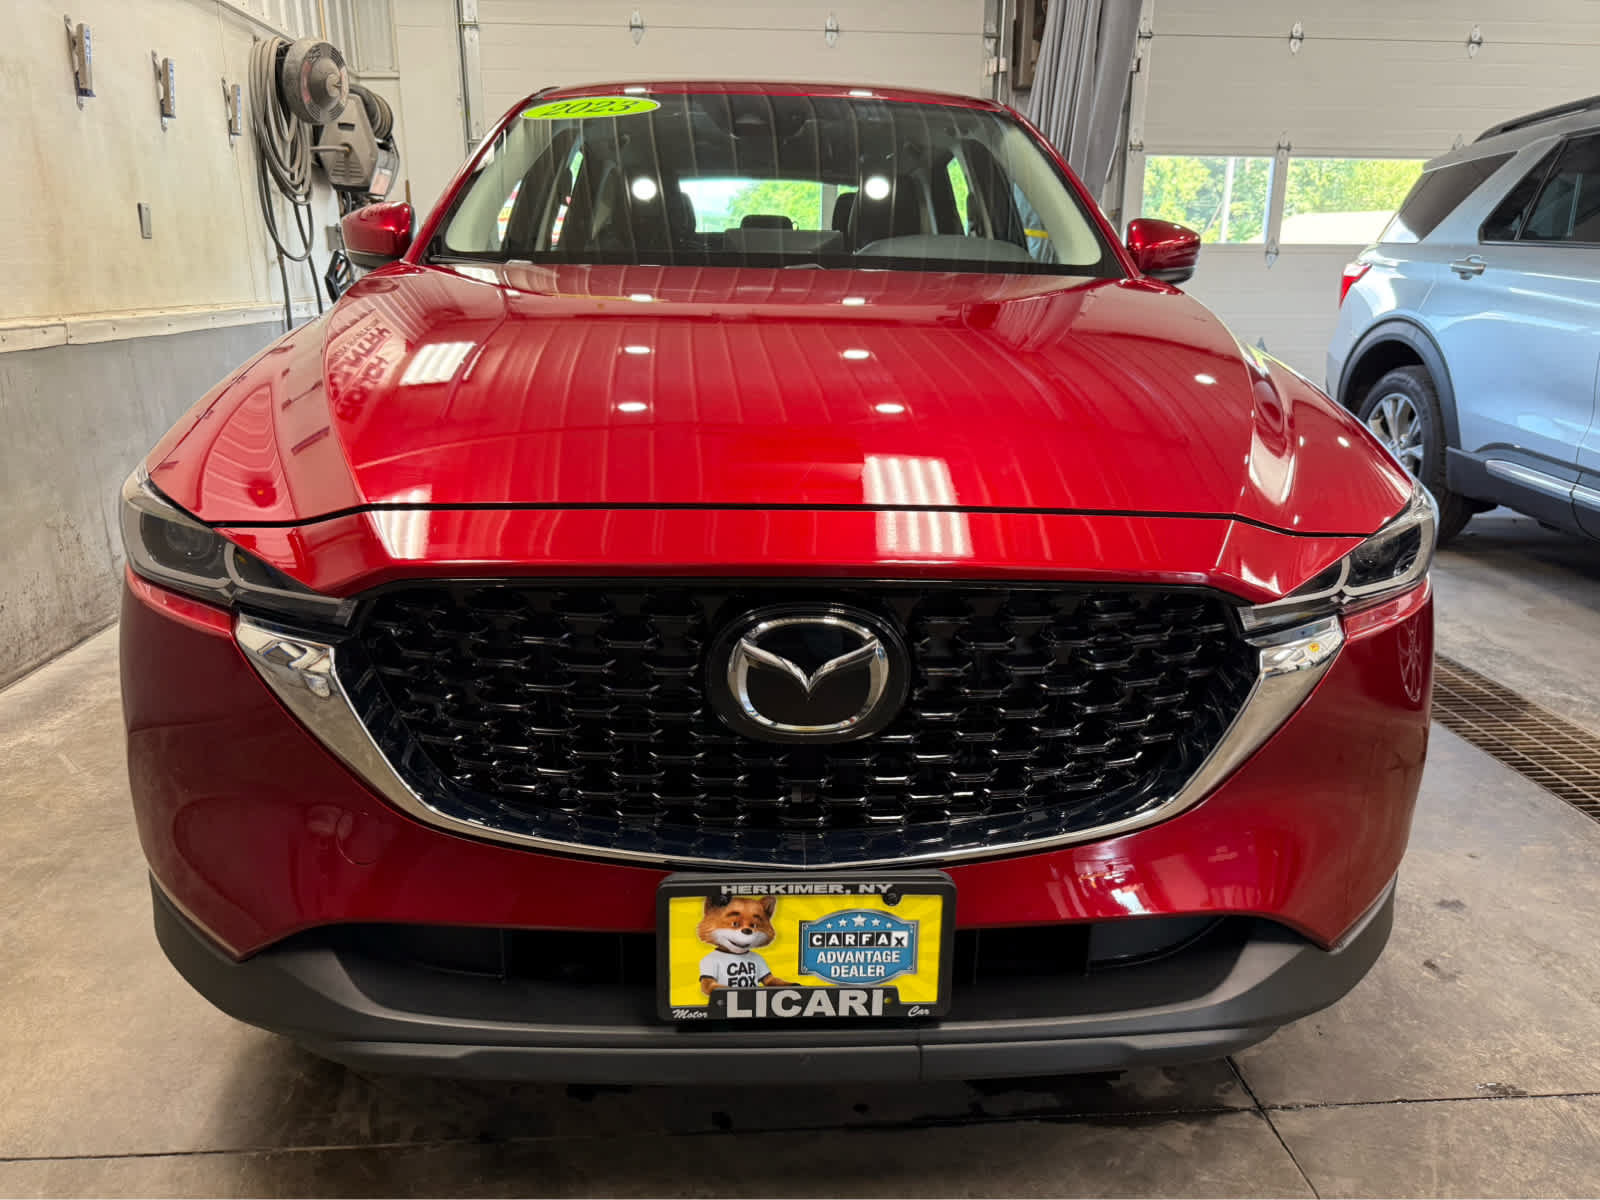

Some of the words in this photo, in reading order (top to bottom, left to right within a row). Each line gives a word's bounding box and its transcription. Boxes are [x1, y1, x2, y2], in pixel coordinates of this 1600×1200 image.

[538, 100, 640, 118] 2023
[720, 884, 852, 895] HERKIMER,
[858, 884, 893, 894] NY
[811, 932, 906, 947] CARFAX
[816, 950, 901, 964] ADVANTAGE
[726, 961, 756, 976] CAR
[830, 965, 886, 978] DEALER
[727, 976, 757, 988] FOX
[671, 1008, 708, 1019] Motor
[726, 989, 884, 1018] LICARI
[907, 1005, 931, 1017] Car
